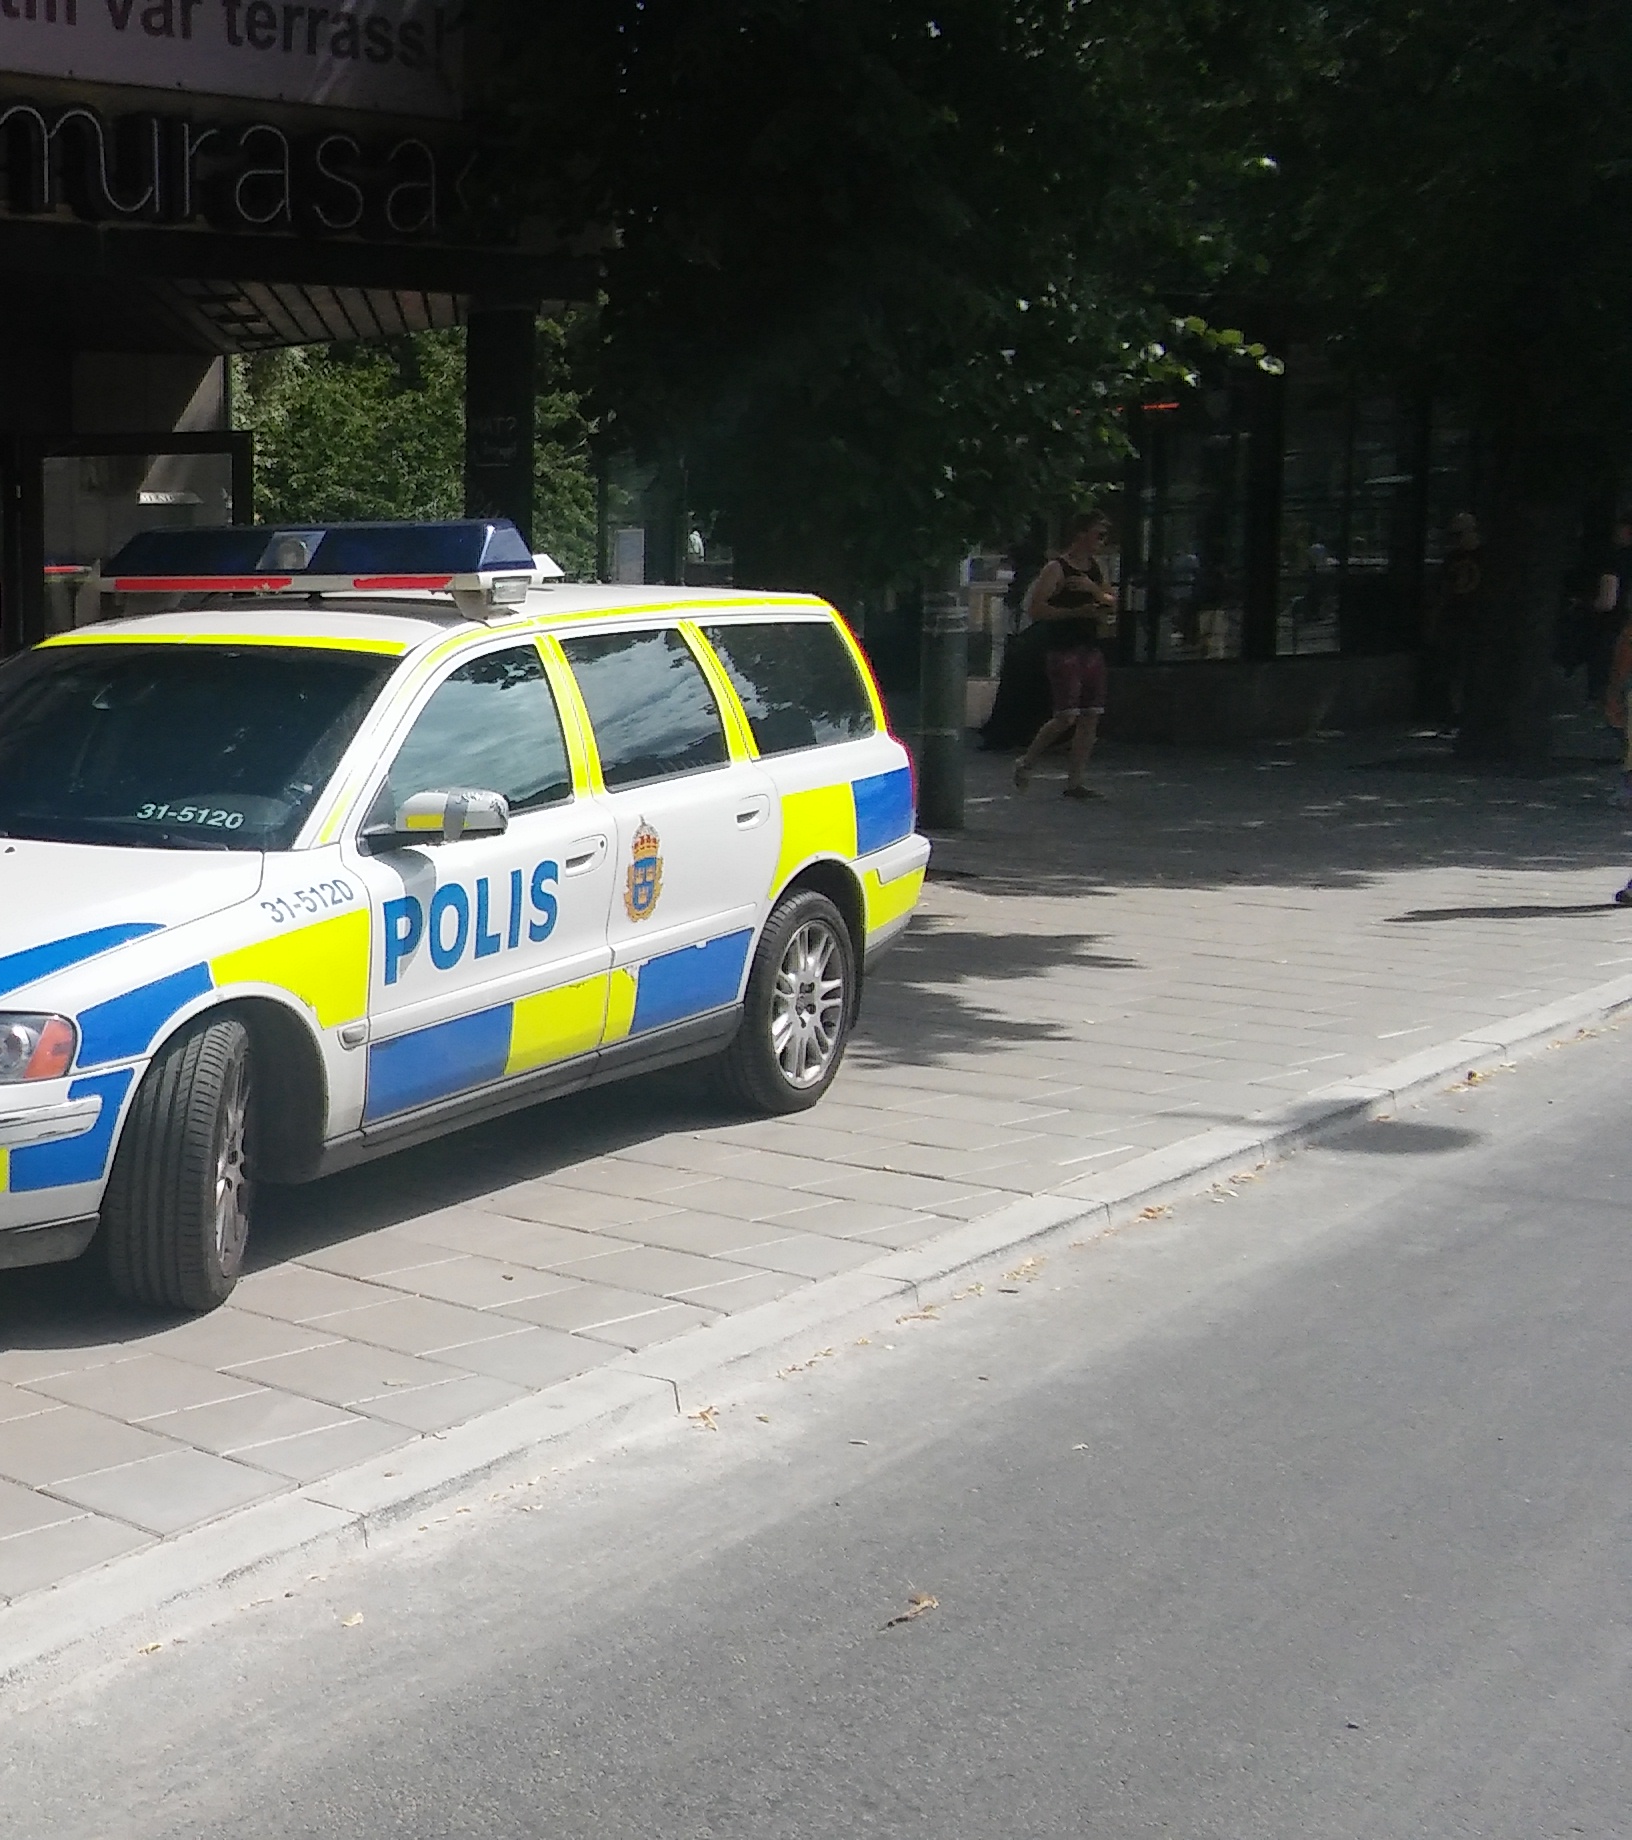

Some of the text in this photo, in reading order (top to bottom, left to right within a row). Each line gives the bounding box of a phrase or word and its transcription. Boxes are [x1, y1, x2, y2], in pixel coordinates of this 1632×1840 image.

[221, 0, 445, 72] terrass!
[137, 803, 245, 830] 31-5120
[260, 879, 355, 923] 31-5120
[382, 859, 560, 986] POLIS
